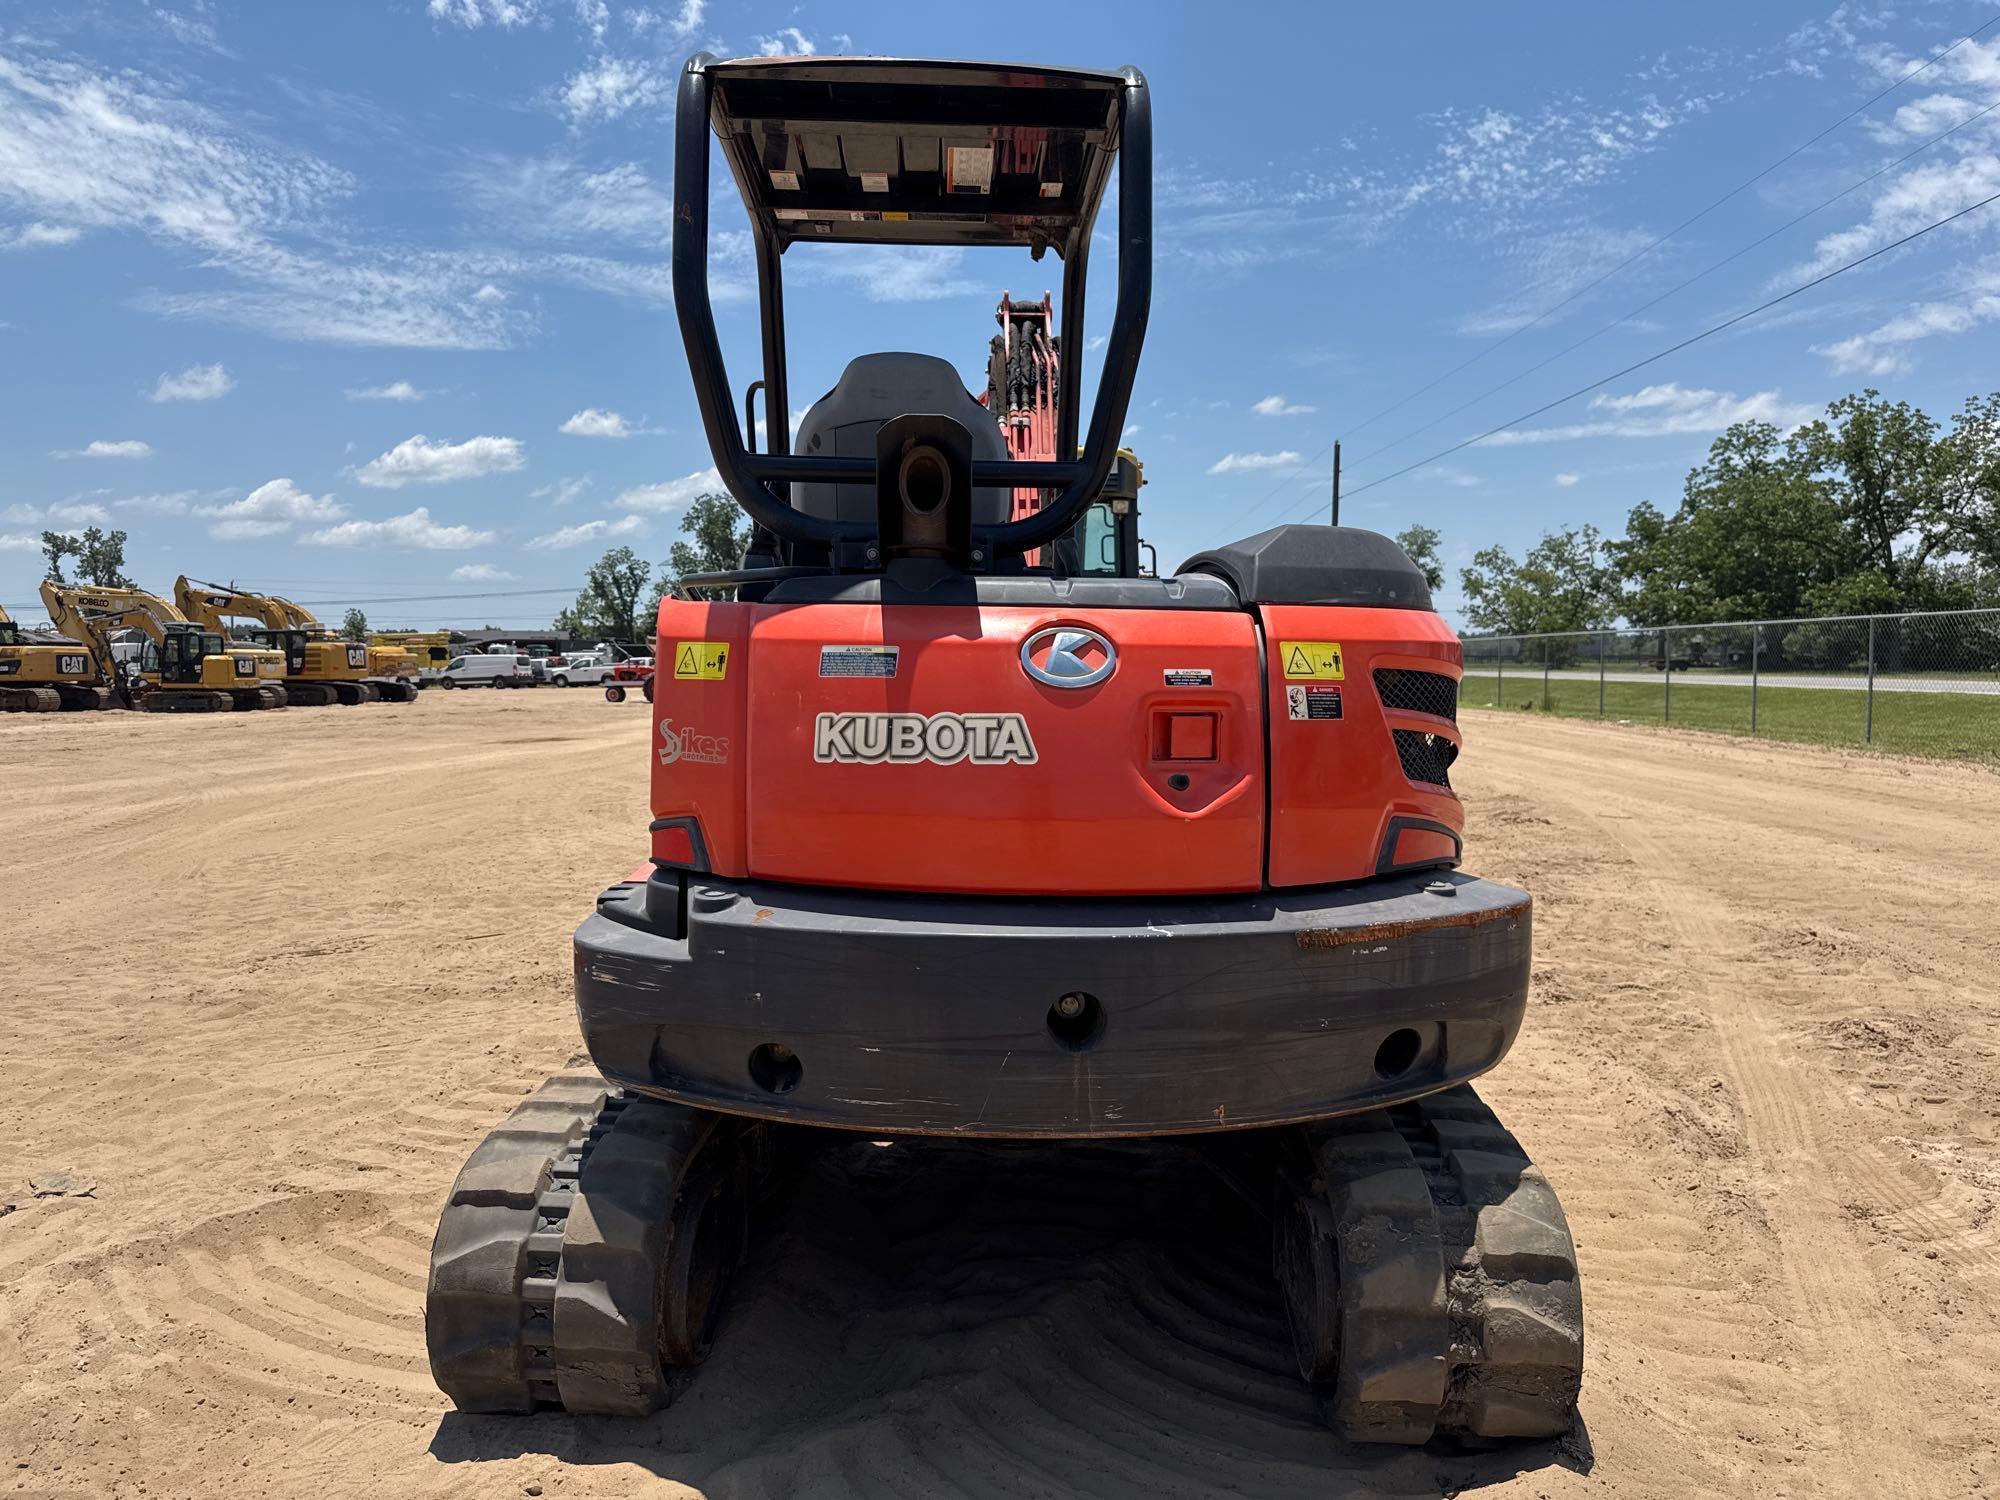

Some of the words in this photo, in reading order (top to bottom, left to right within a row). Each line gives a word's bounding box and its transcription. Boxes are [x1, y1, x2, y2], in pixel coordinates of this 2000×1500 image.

[78, 597, 110, 607] KOBELCO
[213, 597, 227, 607] CAT
[61, 656, 84, 673] CAT
[348, 649, 365, 666] CAT
[239, 660, 254, 673] CAT
[657, 718, 730, 765] Sikes
[817, 716, 1033, 759] KUBOTA
